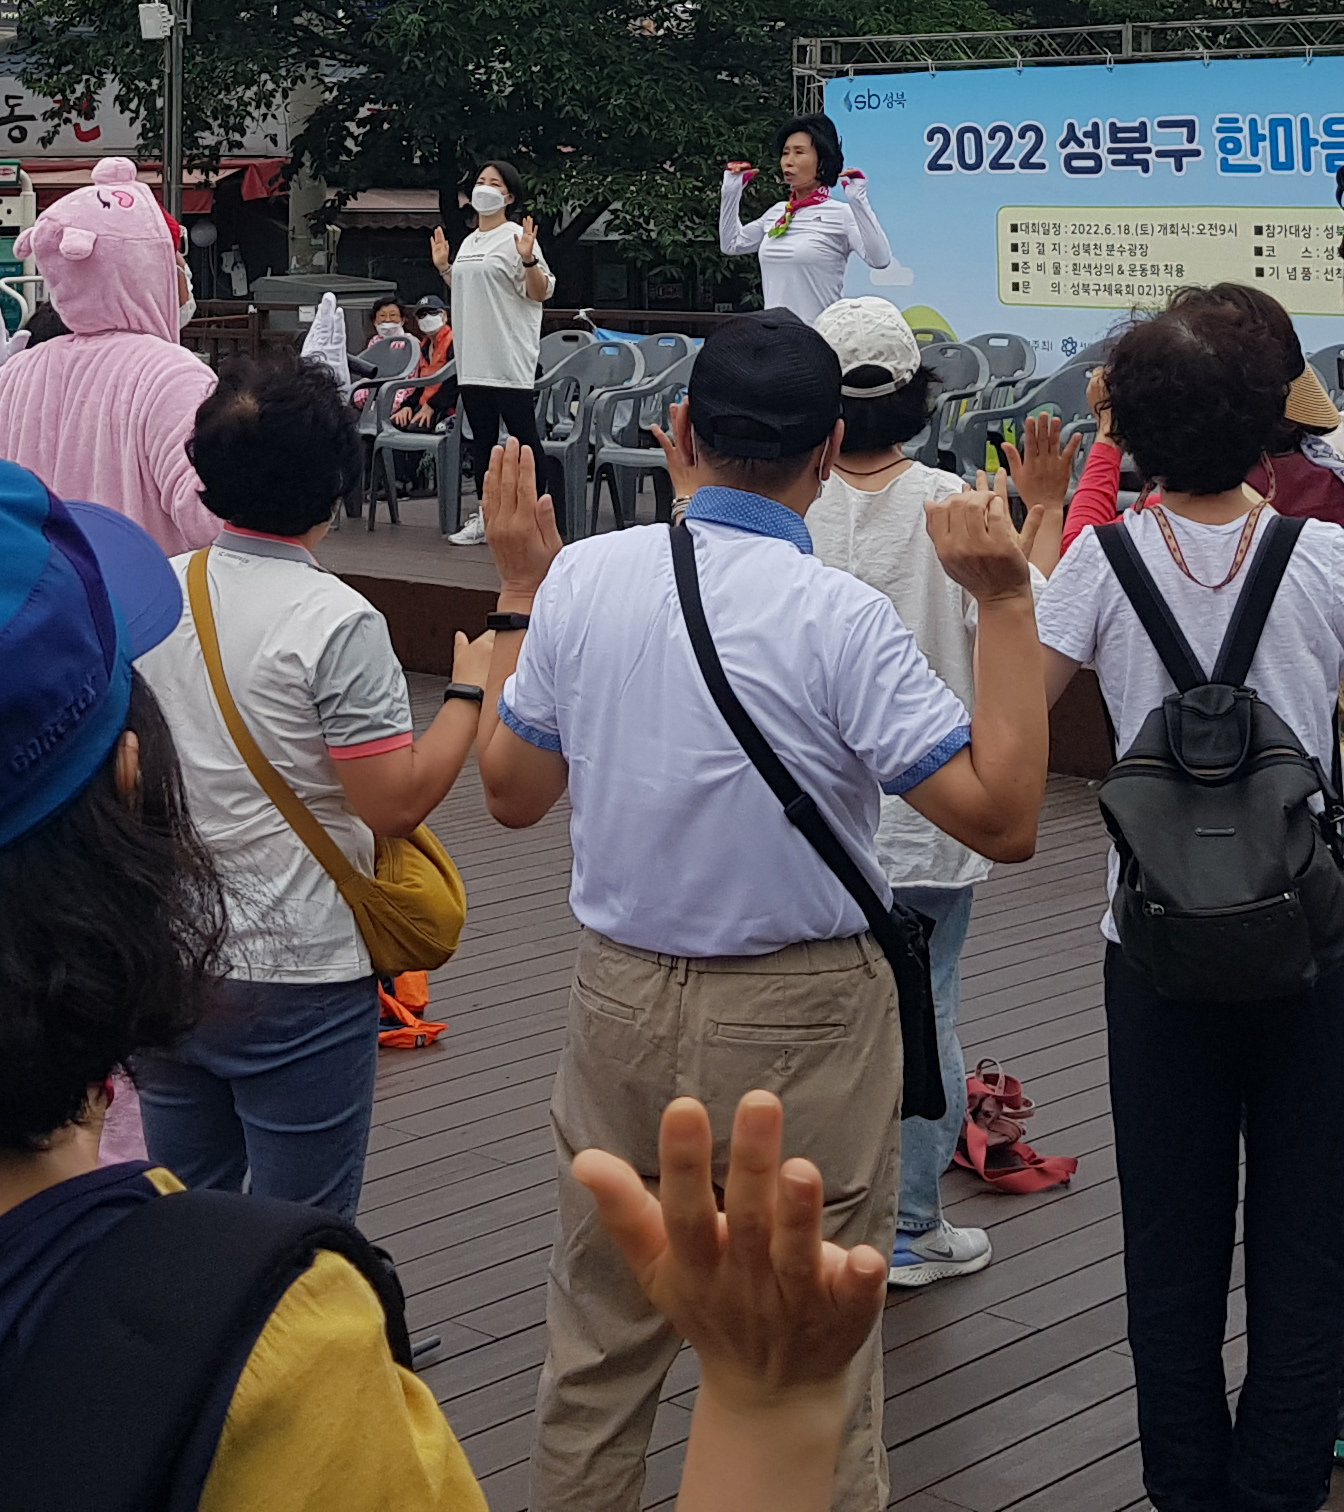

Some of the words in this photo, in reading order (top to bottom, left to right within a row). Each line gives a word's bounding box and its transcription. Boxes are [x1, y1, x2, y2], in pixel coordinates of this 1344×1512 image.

[882, 91, 907, 109] 성북
[925, 122, 1048, 173] 2022
[1057, 118, 1203, 176] 성북구
[1019, 221, 1062, 237] 대회일정
[1265, 223, 1312, 239] 참가대상
[1070, 241, 1103, 257] 성북천
[1105, 243, 1149, 258] 분수광장
[1070, 262, 1114, 277] 흰색상의
[1127, 263, 1160, 278] 운동화
[1163, 264, 1185, 278] 착용
[1070, 282, 1136, 297] 성북구체육회
